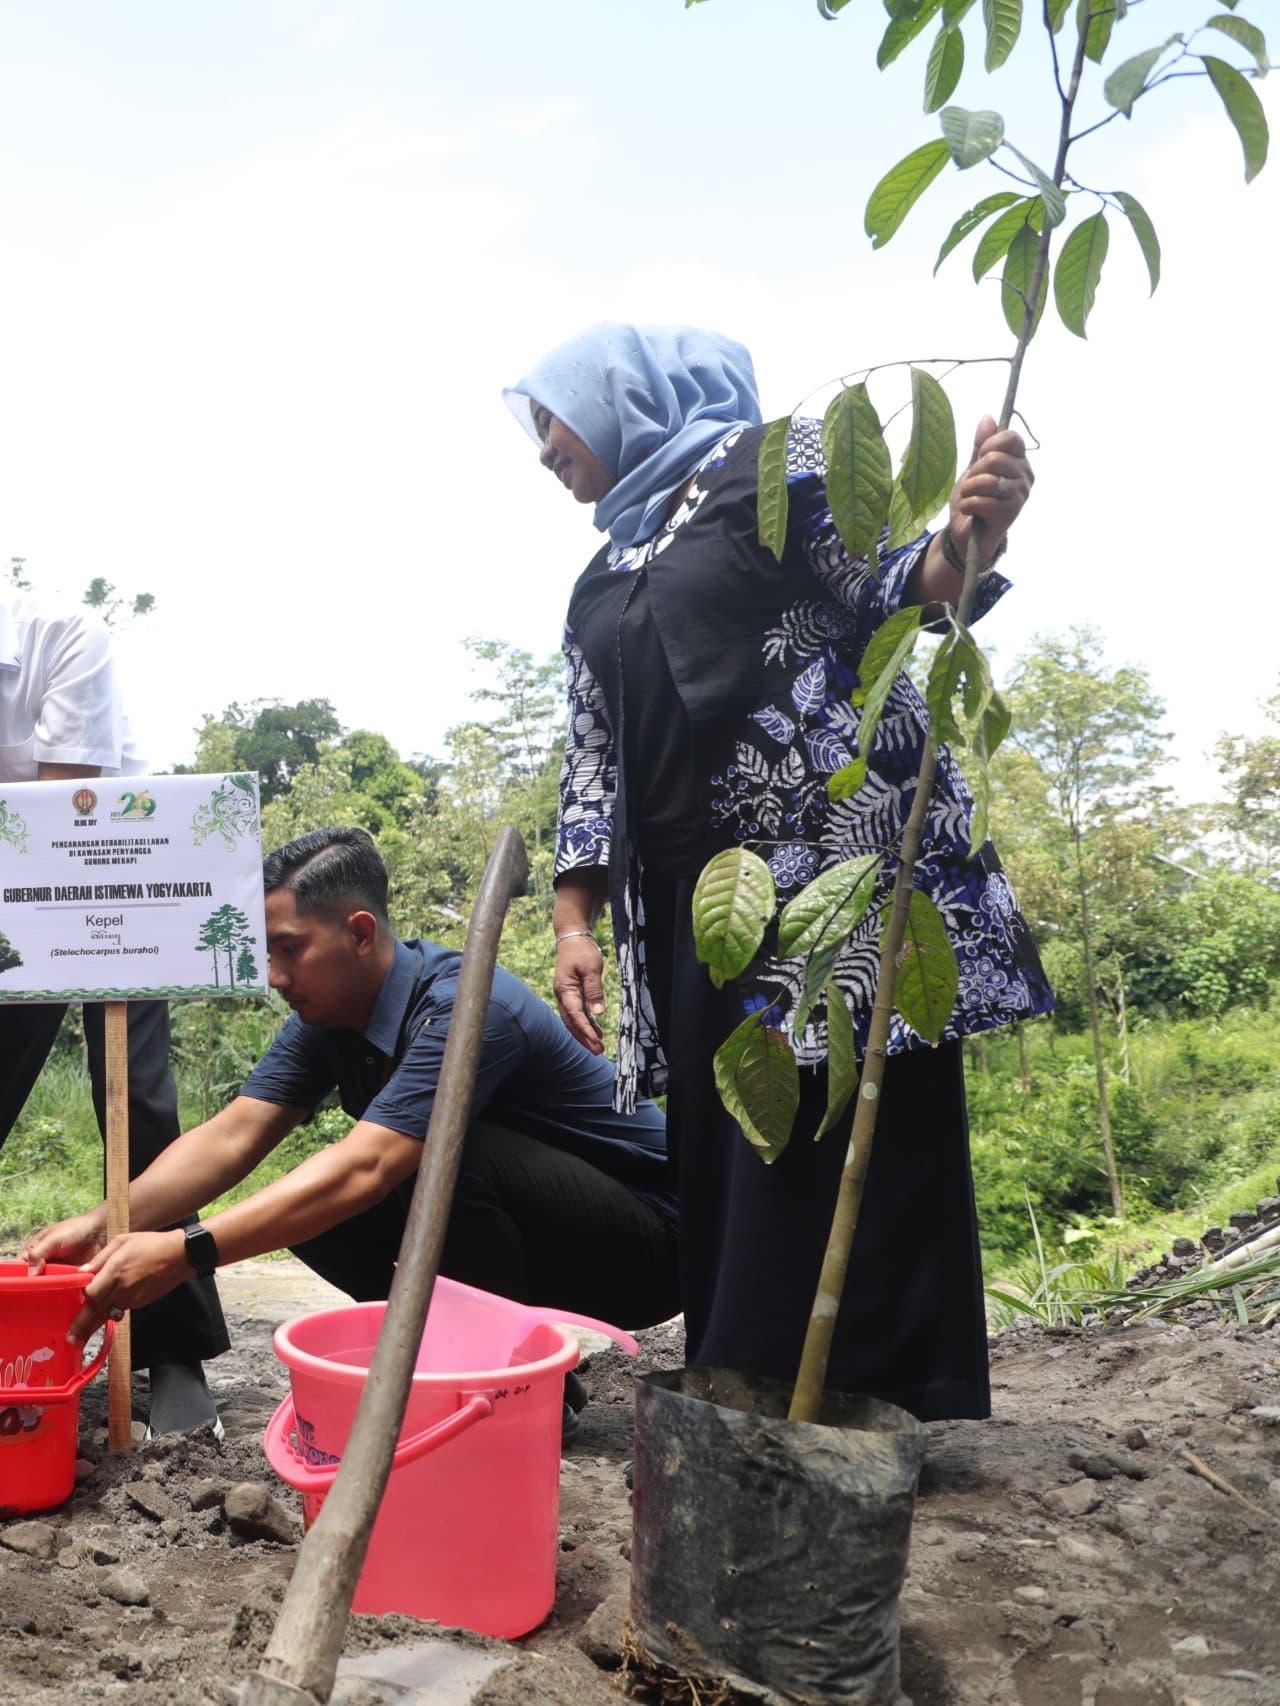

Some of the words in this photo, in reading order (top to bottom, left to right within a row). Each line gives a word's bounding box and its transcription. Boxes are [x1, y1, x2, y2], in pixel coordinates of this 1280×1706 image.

[77, 848, 111, 857] KAWASAN
[112, 847, 152, 856] PENYANGGA
[84, 858, 110, 866] GUNUNG
[112, 857, 137, 865] MERAPI
[3, 886, 52, 903] GUBERNUR
[54, 885, 93, 902] DAERAH
[94, 883, 144, 900] ISTIMEWA
[146, 882, 212, 899] YOGYAKARTA
[86, 914, 123, 928] Kepel
[50, 946, 120, 958] (Stelechocarpus
[122, 945, 159, 956] burahol)
